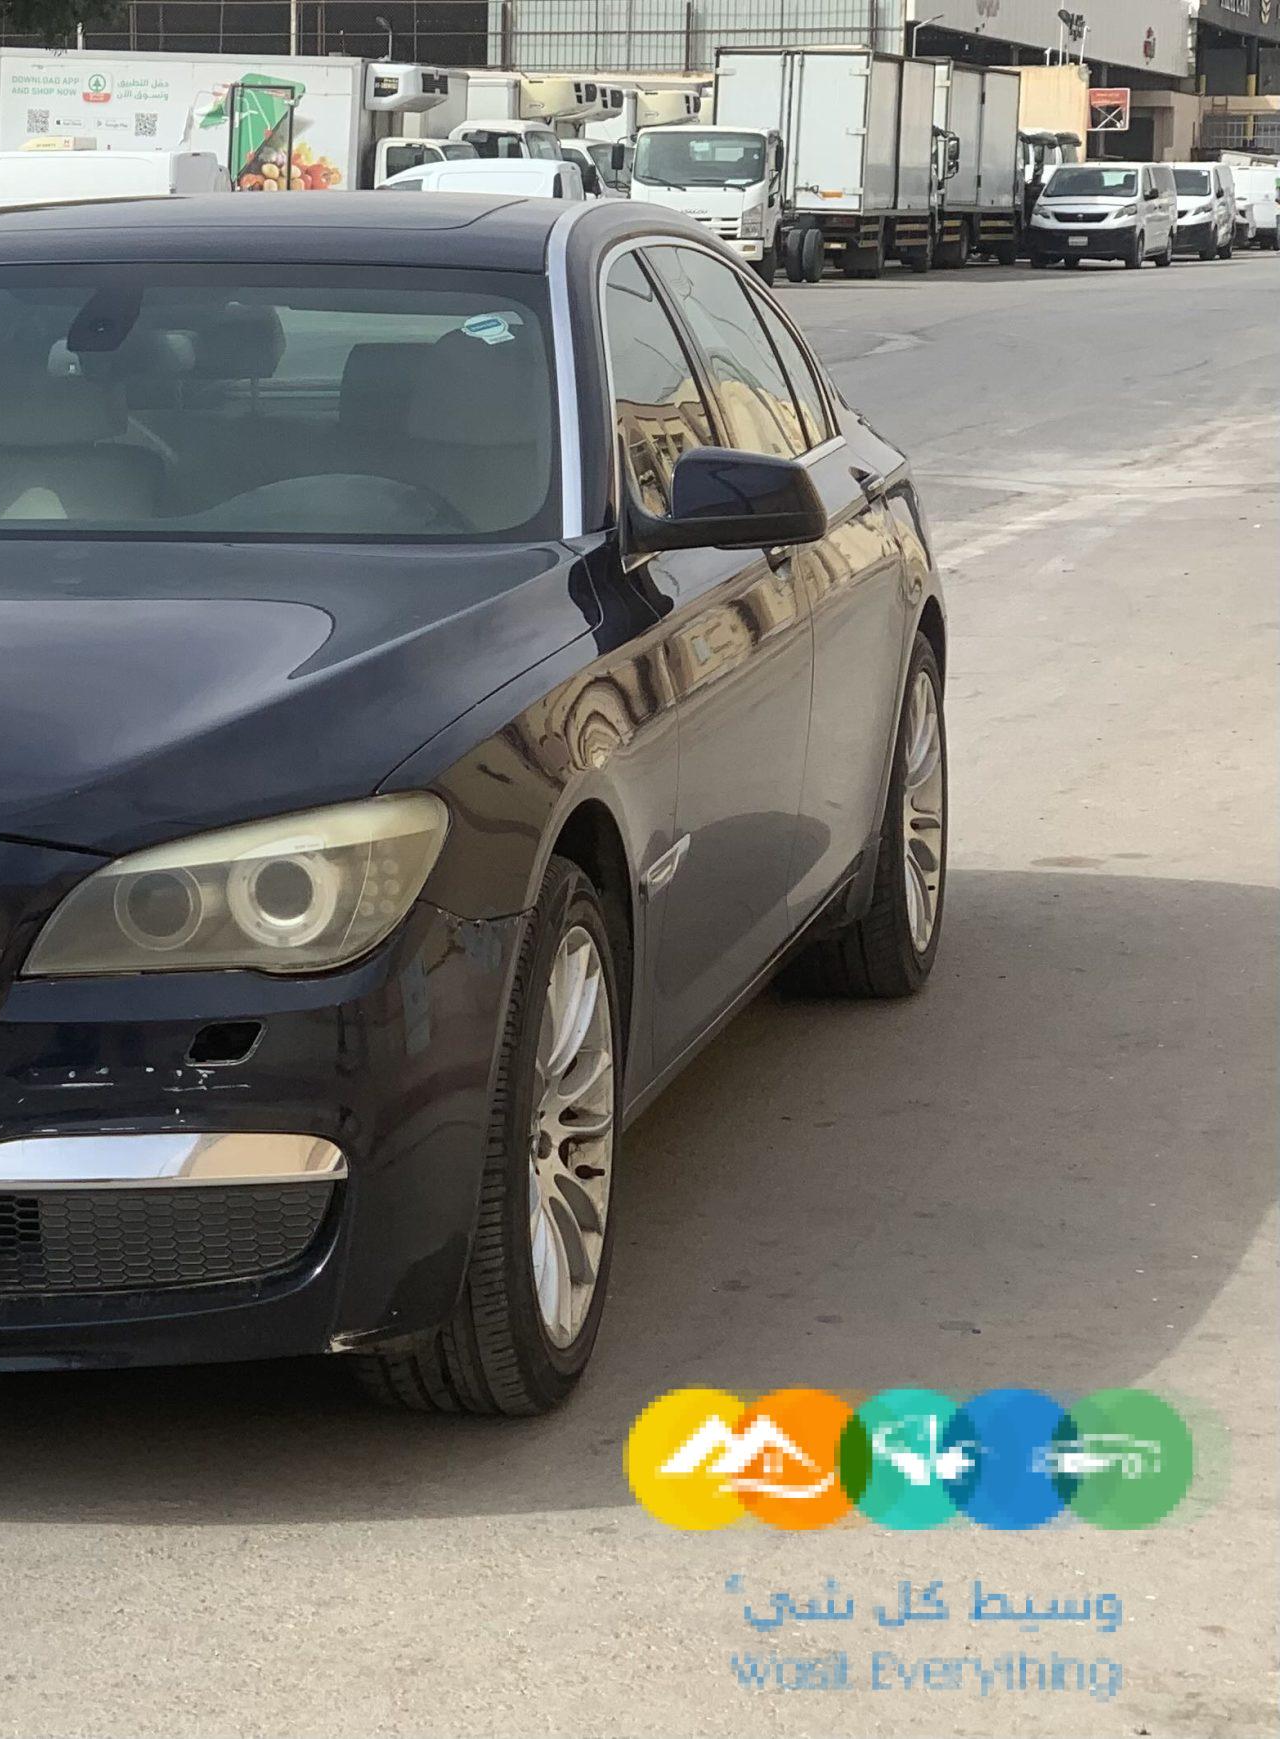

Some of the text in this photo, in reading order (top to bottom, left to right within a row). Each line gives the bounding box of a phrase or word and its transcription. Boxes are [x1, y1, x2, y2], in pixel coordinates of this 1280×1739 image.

[11, 75, 79, 85] DOWNLOAD APP
[11, 87, 30, 95] AND
[57, 88, 77, 96] NOW
